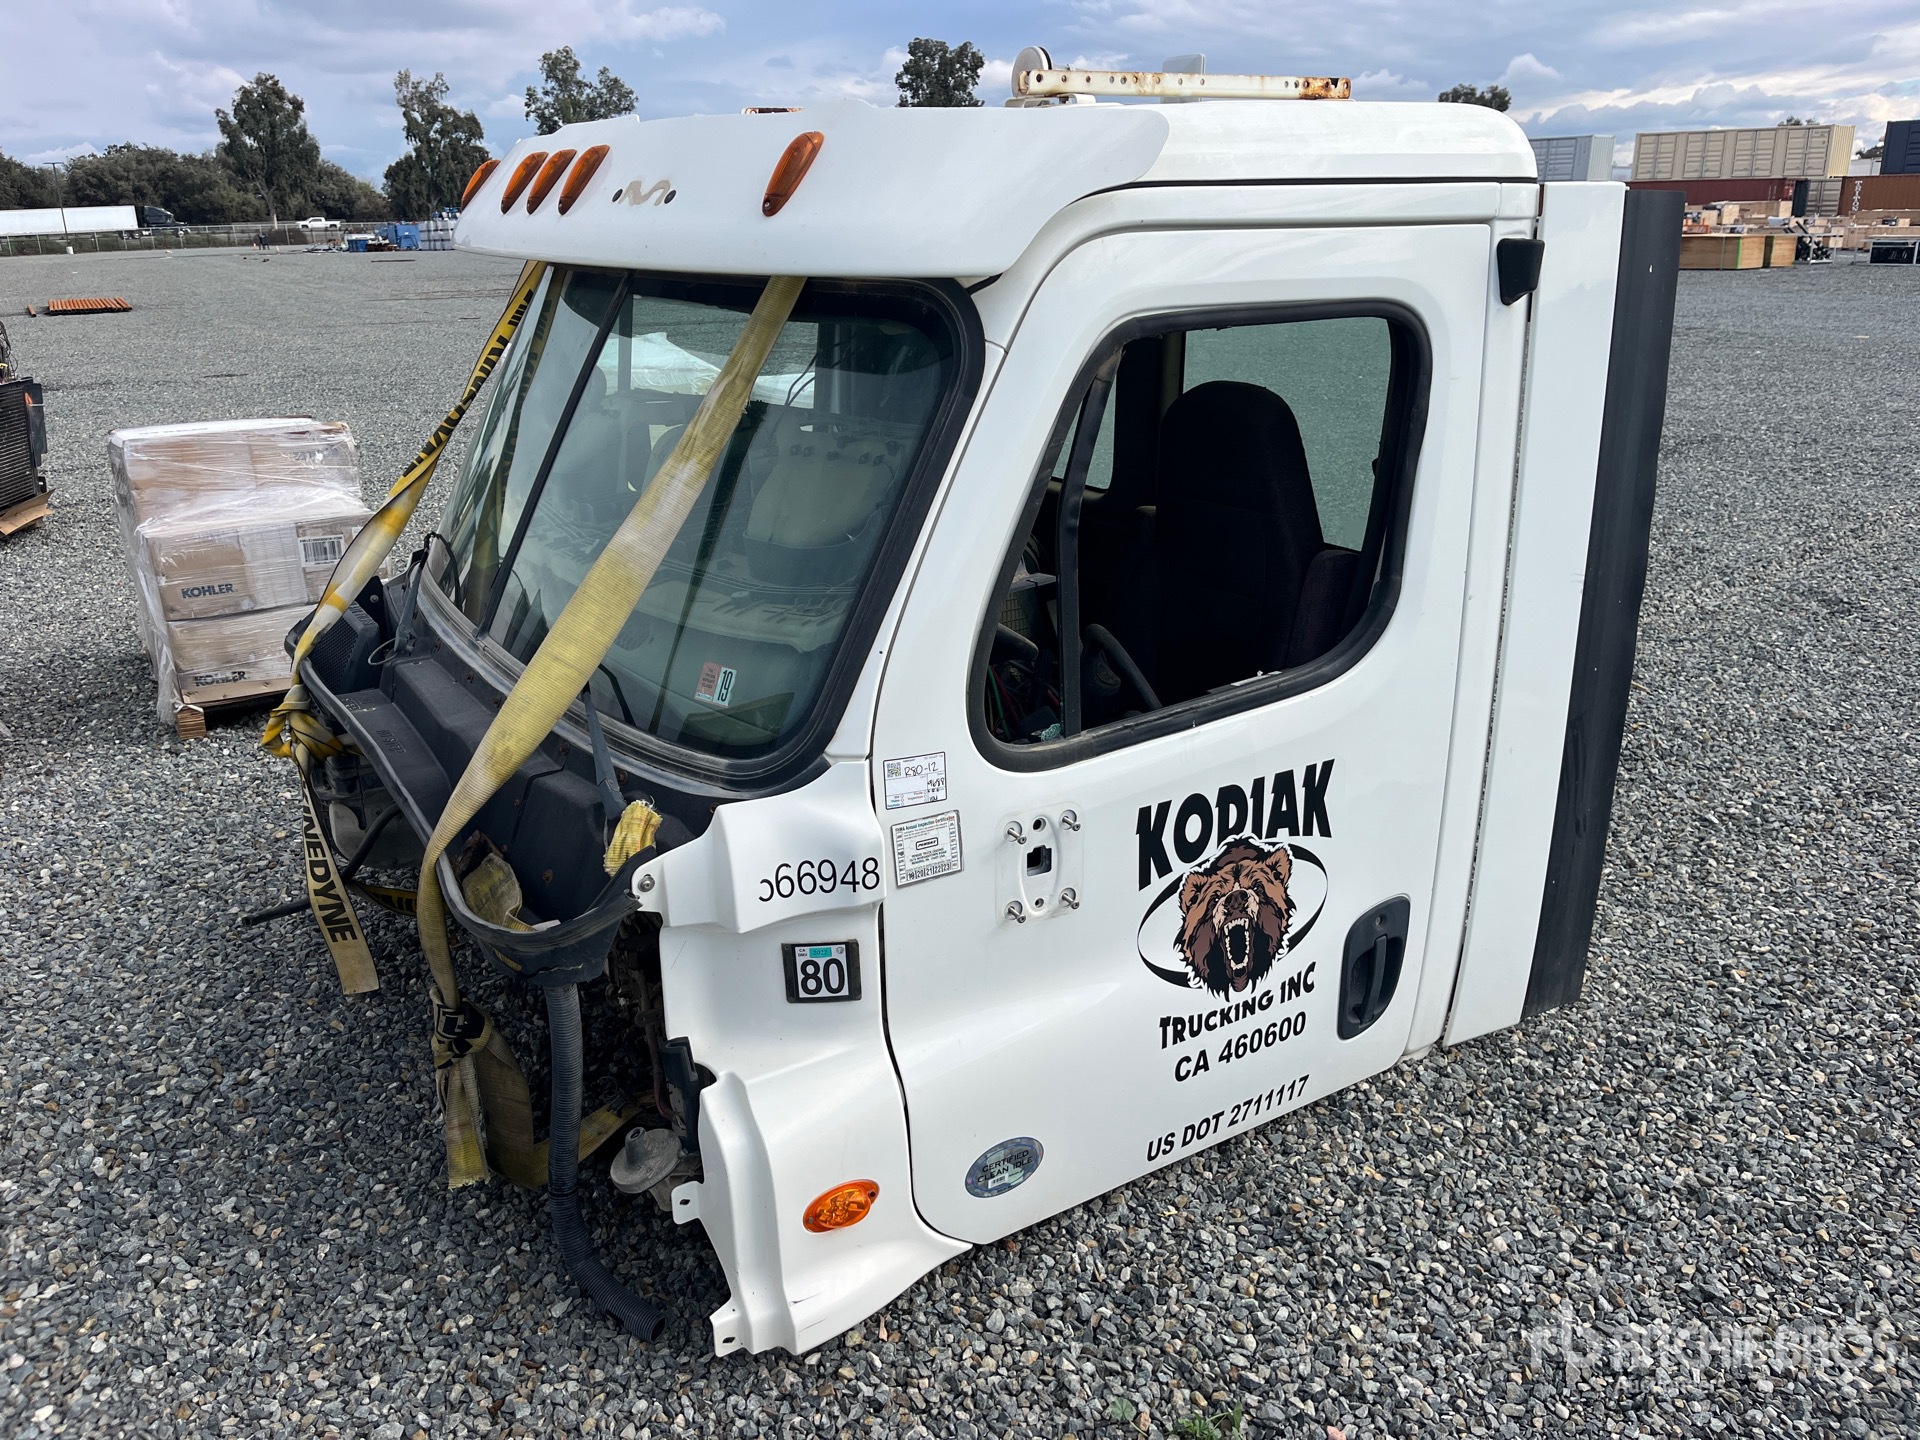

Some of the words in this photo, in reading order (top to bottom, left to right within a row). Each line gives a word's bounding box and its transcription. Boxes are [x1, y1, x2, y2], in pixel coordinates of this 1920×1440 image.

[1851, 180, 1863, 211] TRITON
[181, 583, 235, 599] KOHLER
[717, 669, 734, 702] 19
[1136, 758, 1336, 892] KODIAK
[302, 782, 357, 943] INEDYNE
[800, 957, 846, 996] 80
[1158, 989, 1275, 1050] TRUCKING
[1279, 961, 1317, 1005] INC
[1174, 1048, 1210, 1083] CA
[1217, 1010, 1307, 1064] 460600
[1146, 1131, 1176, 1162] US
[1180, 1110, 1226, 1148] DOT
[1226, 1073, 1310, 1128] 2711117
[977, 1164, 1009, 1183] CLEAN
[1012, 1155, 1034, 1170] IDLE
[981, 1149, 1030, 1173] CERTIFIED
